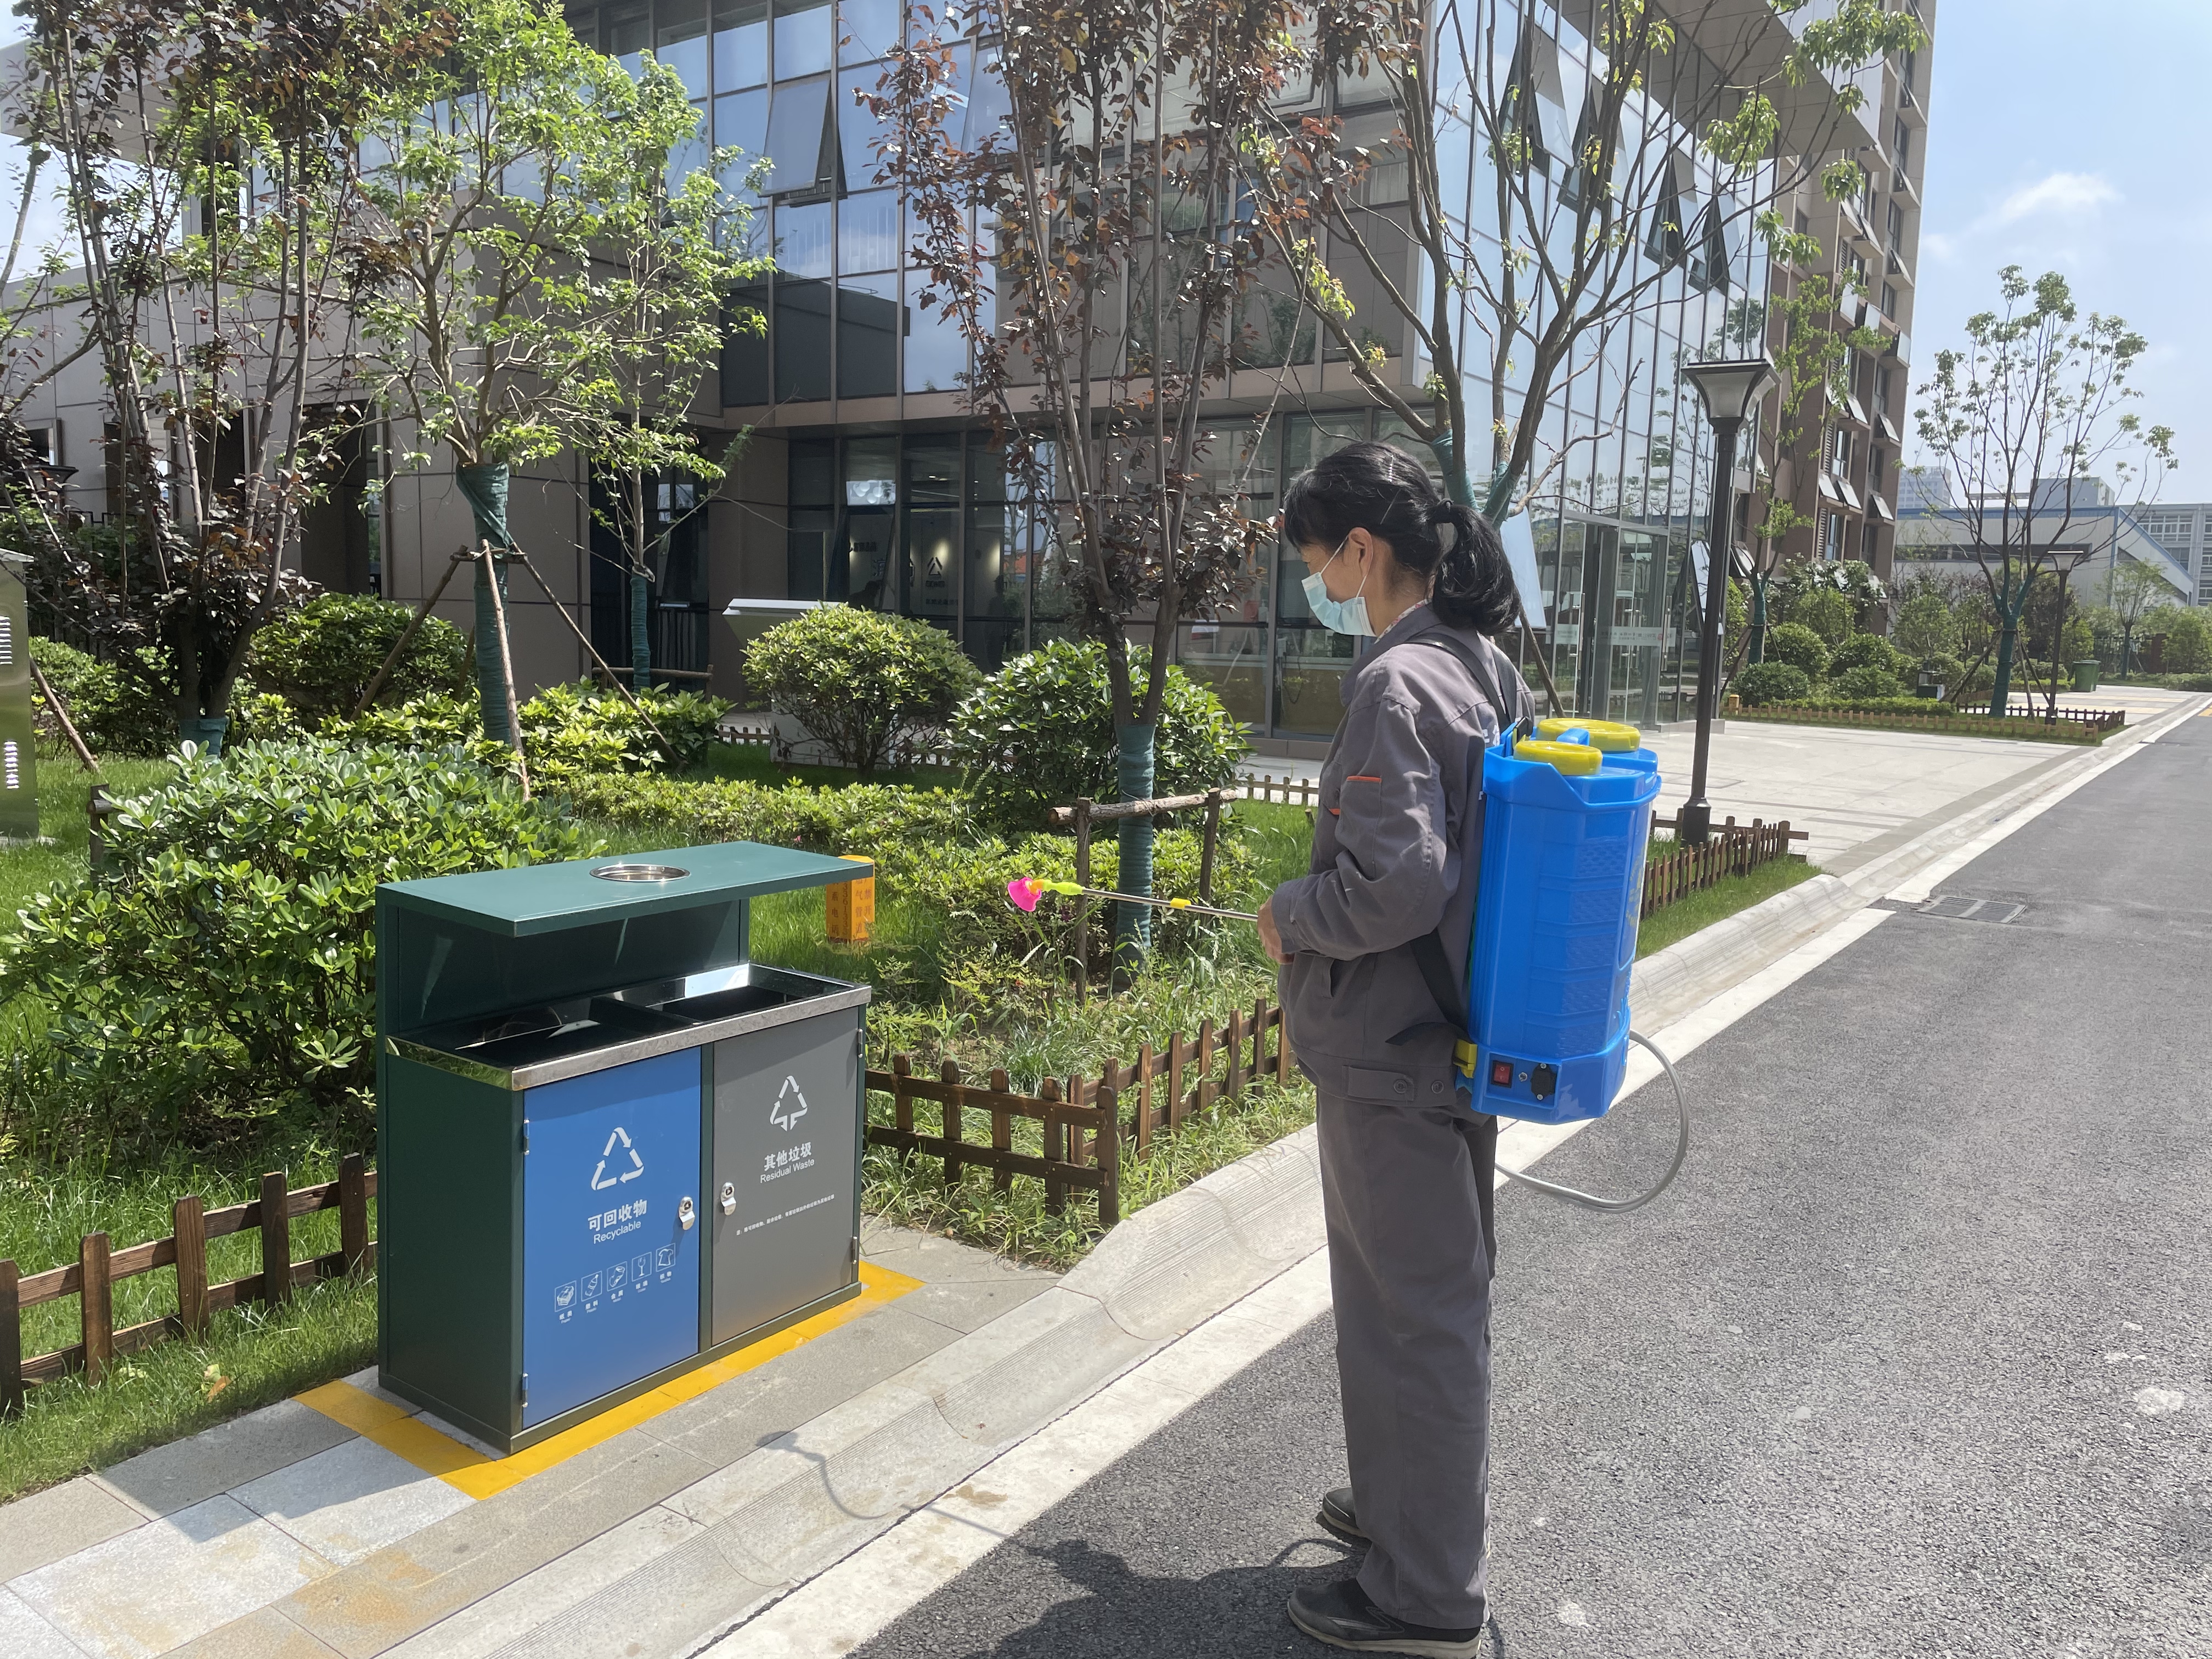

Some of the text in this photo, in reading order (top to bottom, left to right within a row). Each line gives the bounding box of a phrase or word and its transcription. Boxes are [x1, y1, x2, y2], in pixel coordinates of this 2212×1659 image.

[764, 1142, 812, 1172] 其他垃圾
[760, 1159, 815, 1184] Residual Waste
[588, 1199, 647, 1232] 可回收物
[593, 1221, 641, 1244] Recyclable
